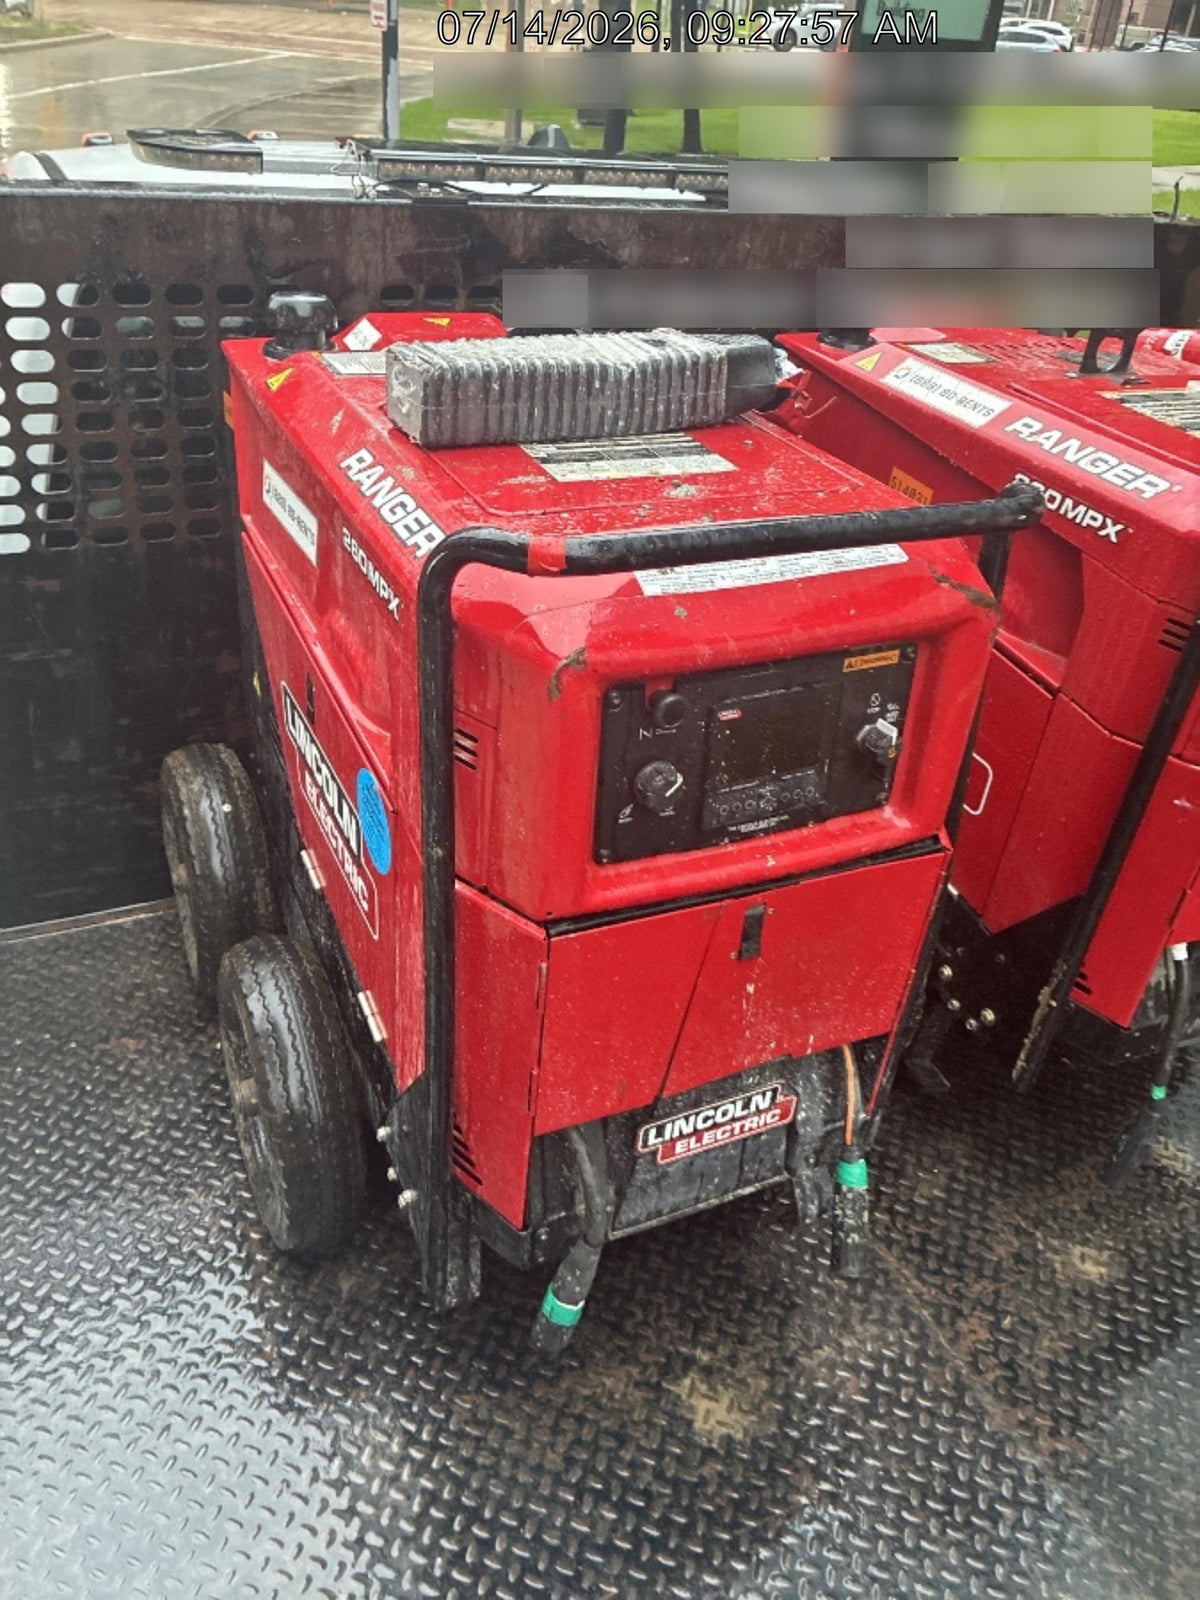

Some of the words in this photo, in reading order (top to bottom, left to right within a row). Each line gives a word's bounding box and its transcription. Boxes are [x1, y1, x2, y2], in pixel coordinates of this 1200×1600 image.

[338, 447, 446, 559] RANGER
[1003, 415, 1171, 500] RANGER
[285, 695, 359, 856] LINCOLN
[304, 769, 369, 912] ELECTRIC
[647, 1090, 772, 1146] LINCOLN
[674, 1108, 781, 1154] ELECTRIC
